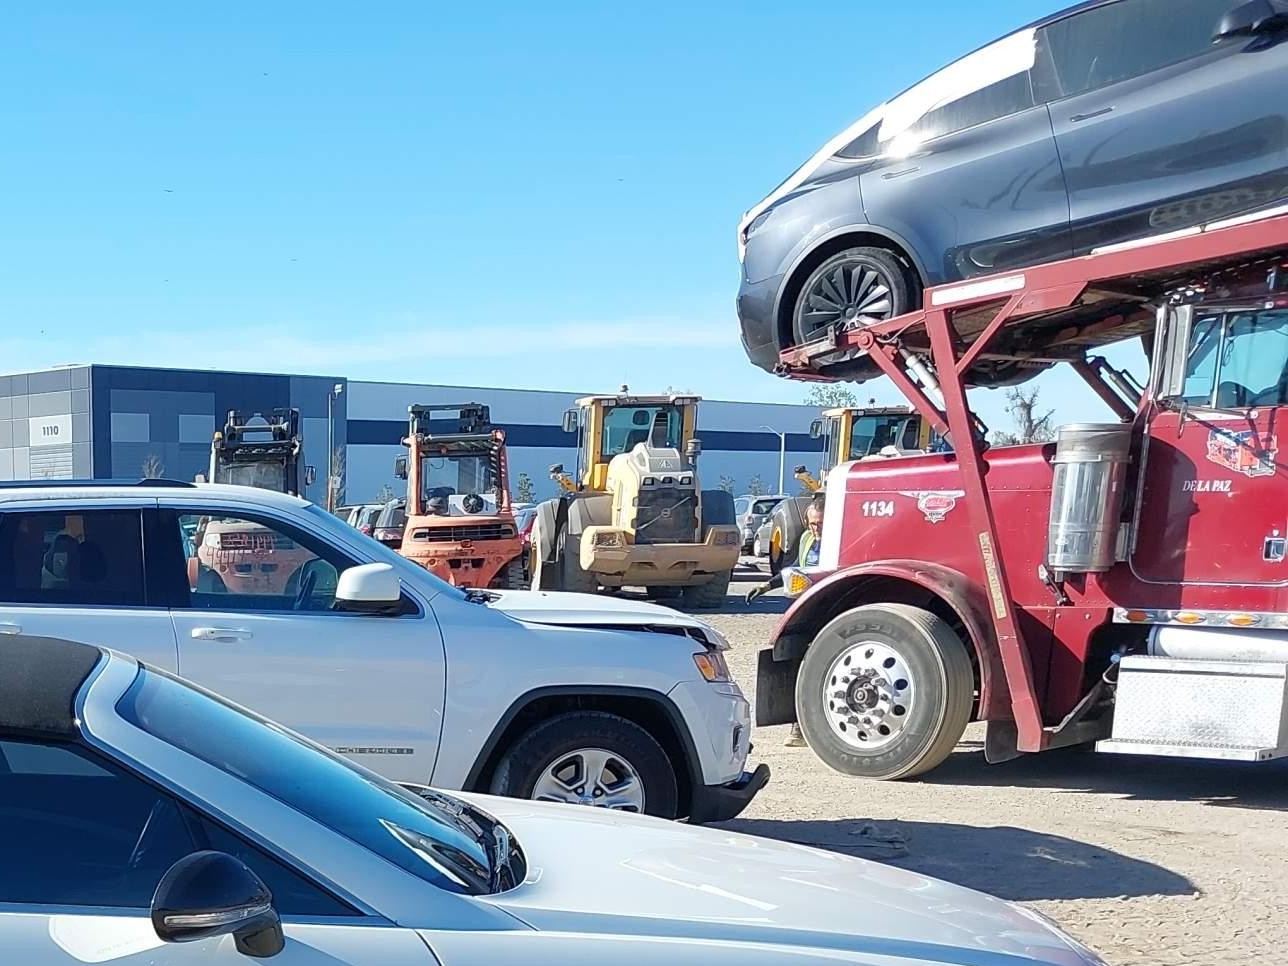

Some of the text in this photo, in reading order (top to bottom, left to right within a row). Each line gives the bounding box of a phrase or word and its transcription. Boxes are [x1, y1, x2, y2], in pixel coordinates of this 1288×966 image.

[42, 425, 59, 436] 1110
[1212, 480, 1232, 492] PAZ
[862, 501, 894, 517] 1134
